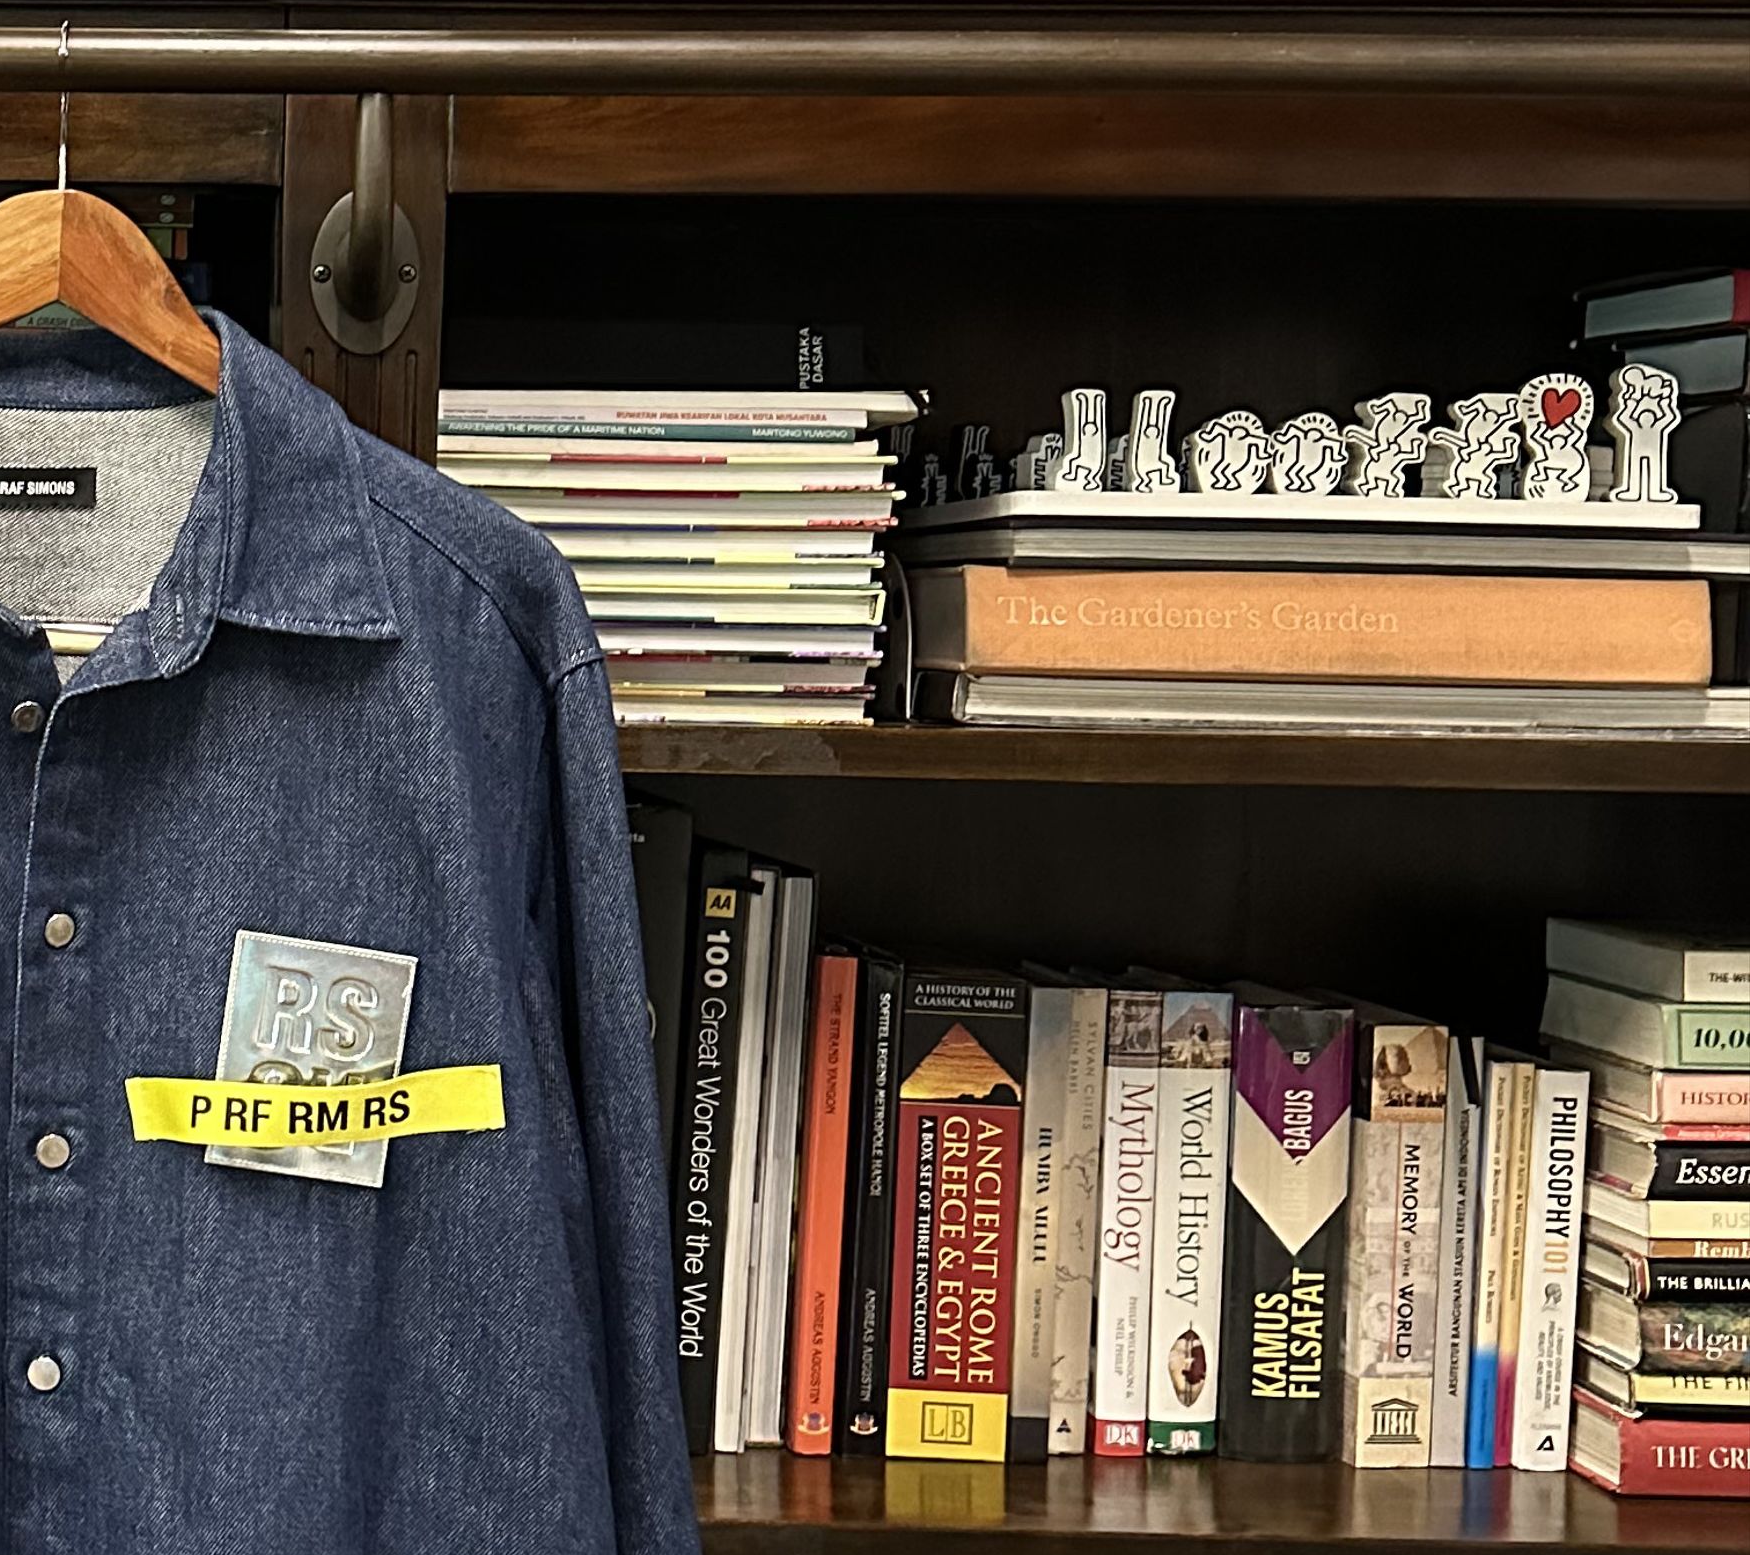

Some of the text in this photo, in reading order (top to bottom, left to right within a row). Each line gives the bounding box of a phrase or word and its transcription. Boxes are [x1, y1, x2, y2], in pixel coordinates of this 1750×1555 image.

[799, 327, 811, 389] PUSTAKA
[812, 335, 823, 383] DASAR
[752, 427, 848, 439] MARTONO YUWONO
[0, 479, 75, 497] RAF SIMONS
[997, 595, 1068, 628] The
[1272, 602, 1399, 634] Garden
[256, 965, 379, 1062] RS
[191, 1090, 410, 1133] P RF RM RS
[678, 929, 730, 1358] 100 Great Wonders of the World
[1281, 1088, 1314, 1152] BAGUS
[1101, 1081, 1156, 1273] Mythology
[1164, 1085, 1215, 1308] World History
[1543, 1096, 1578, 1276] PHILOSOPHY 101
[933, 1115, 971, 1384] GREECE & EGYPT
[967, 1117, 1004, 1386] ANCIENT ROME
[1251, 1289, 1288, 1399] KAMUS
[1287, 1266, 1325, 1399] FILSAFAT
